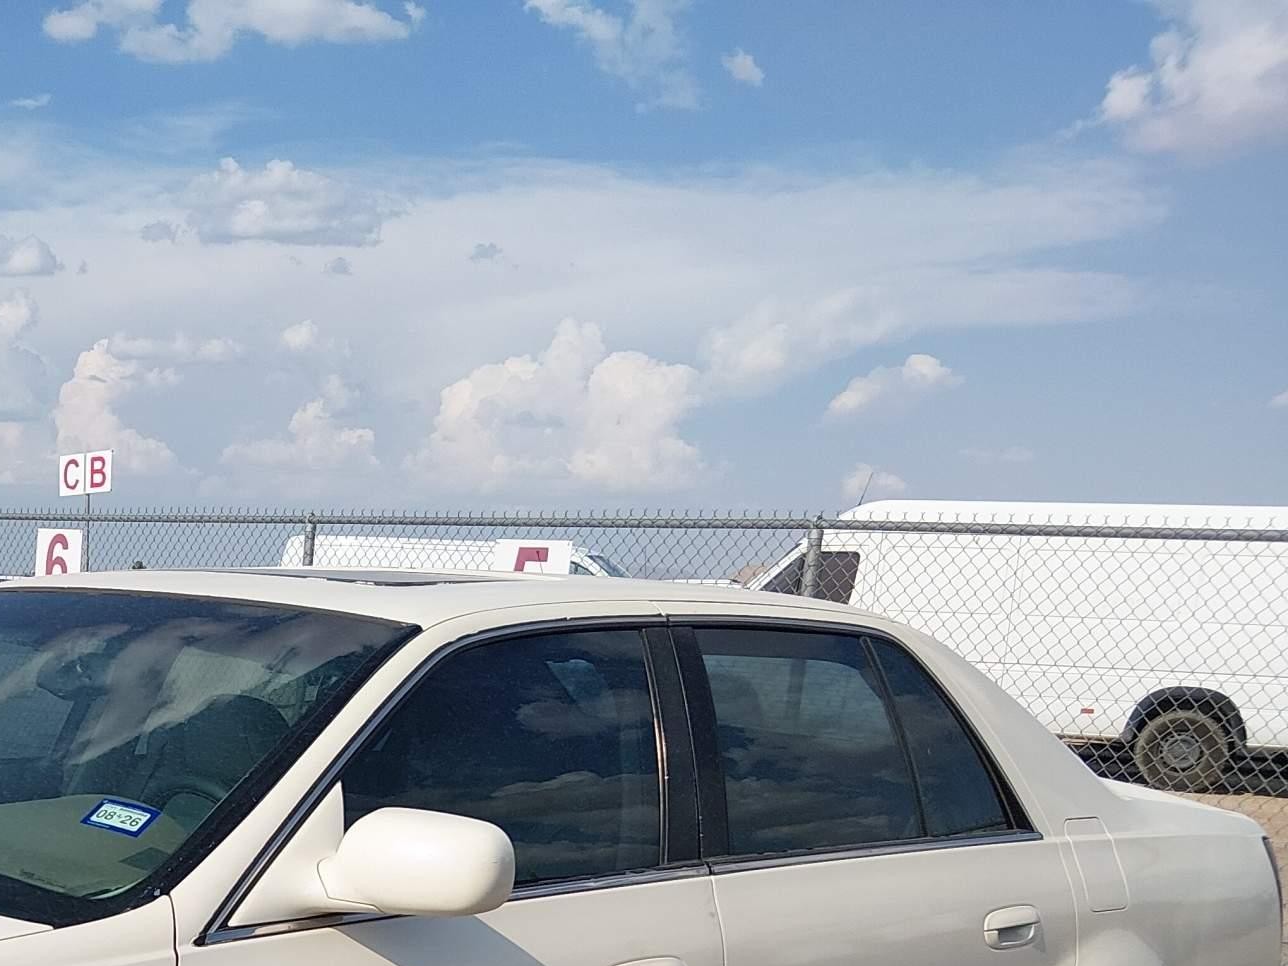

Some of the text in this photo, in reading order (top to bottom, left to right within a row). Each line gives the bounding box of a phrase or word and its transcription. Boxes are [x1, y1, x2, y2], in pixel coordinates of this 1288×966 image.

[63, 456, 107, 490] C B
[45, 533, 69, 575] 6
